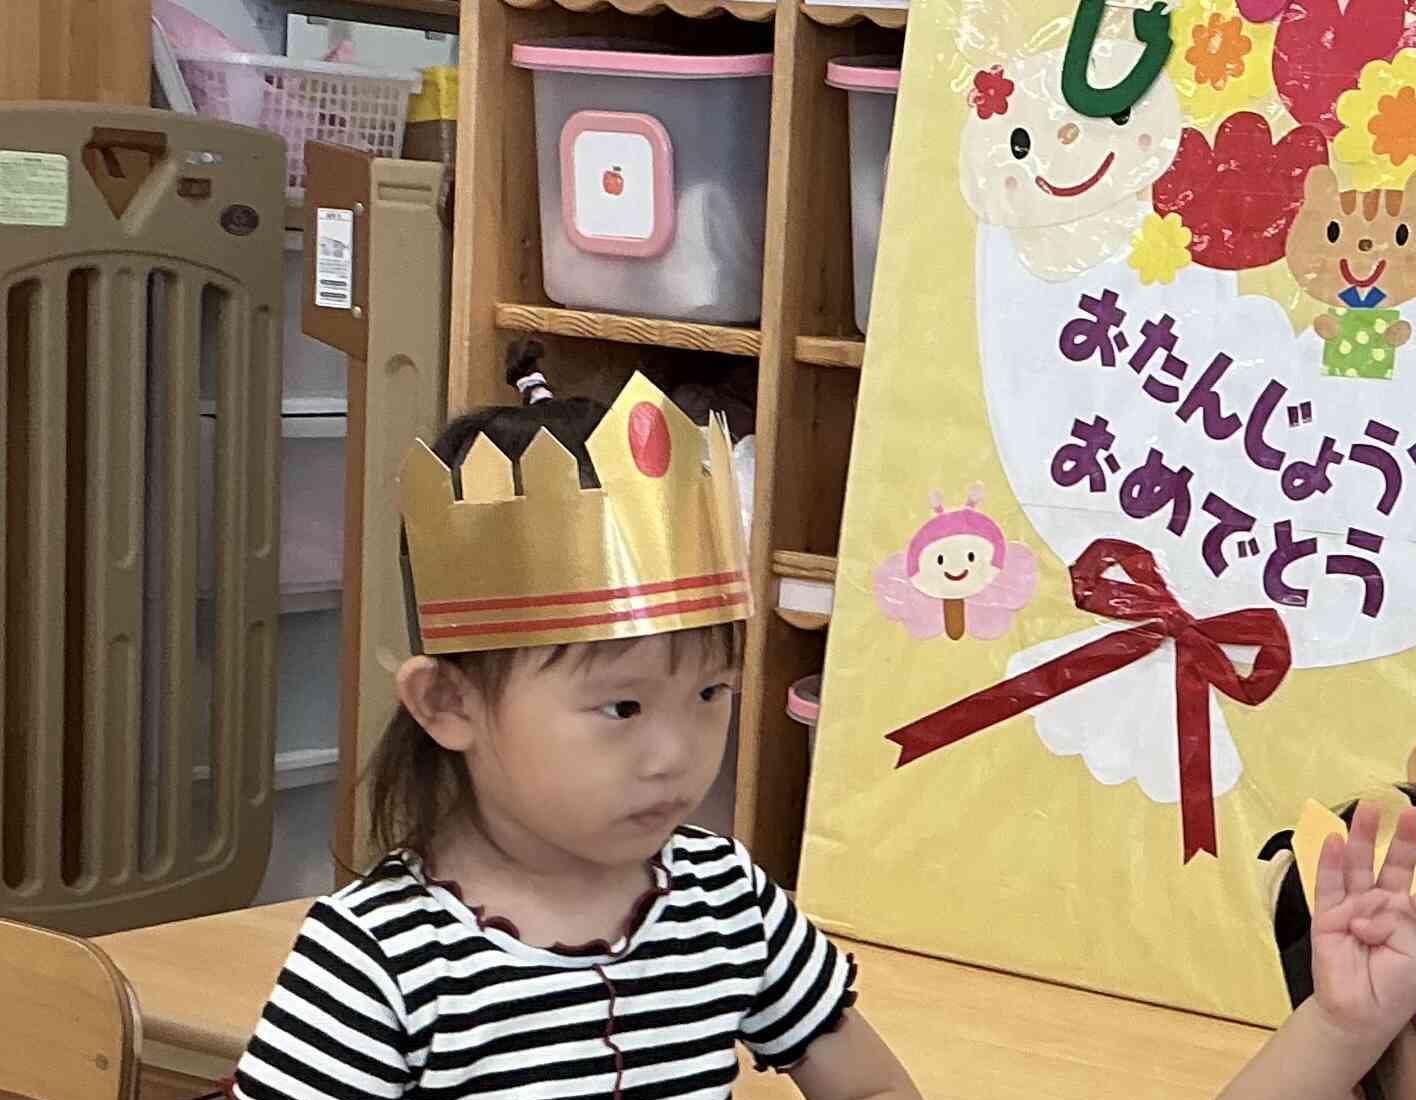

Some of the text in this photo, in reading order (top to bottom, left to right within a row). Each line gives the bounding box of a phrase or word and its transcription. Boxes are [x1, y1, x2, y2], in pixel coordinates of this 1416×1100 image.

[1050, 415, 1386, 618] おめでとう
